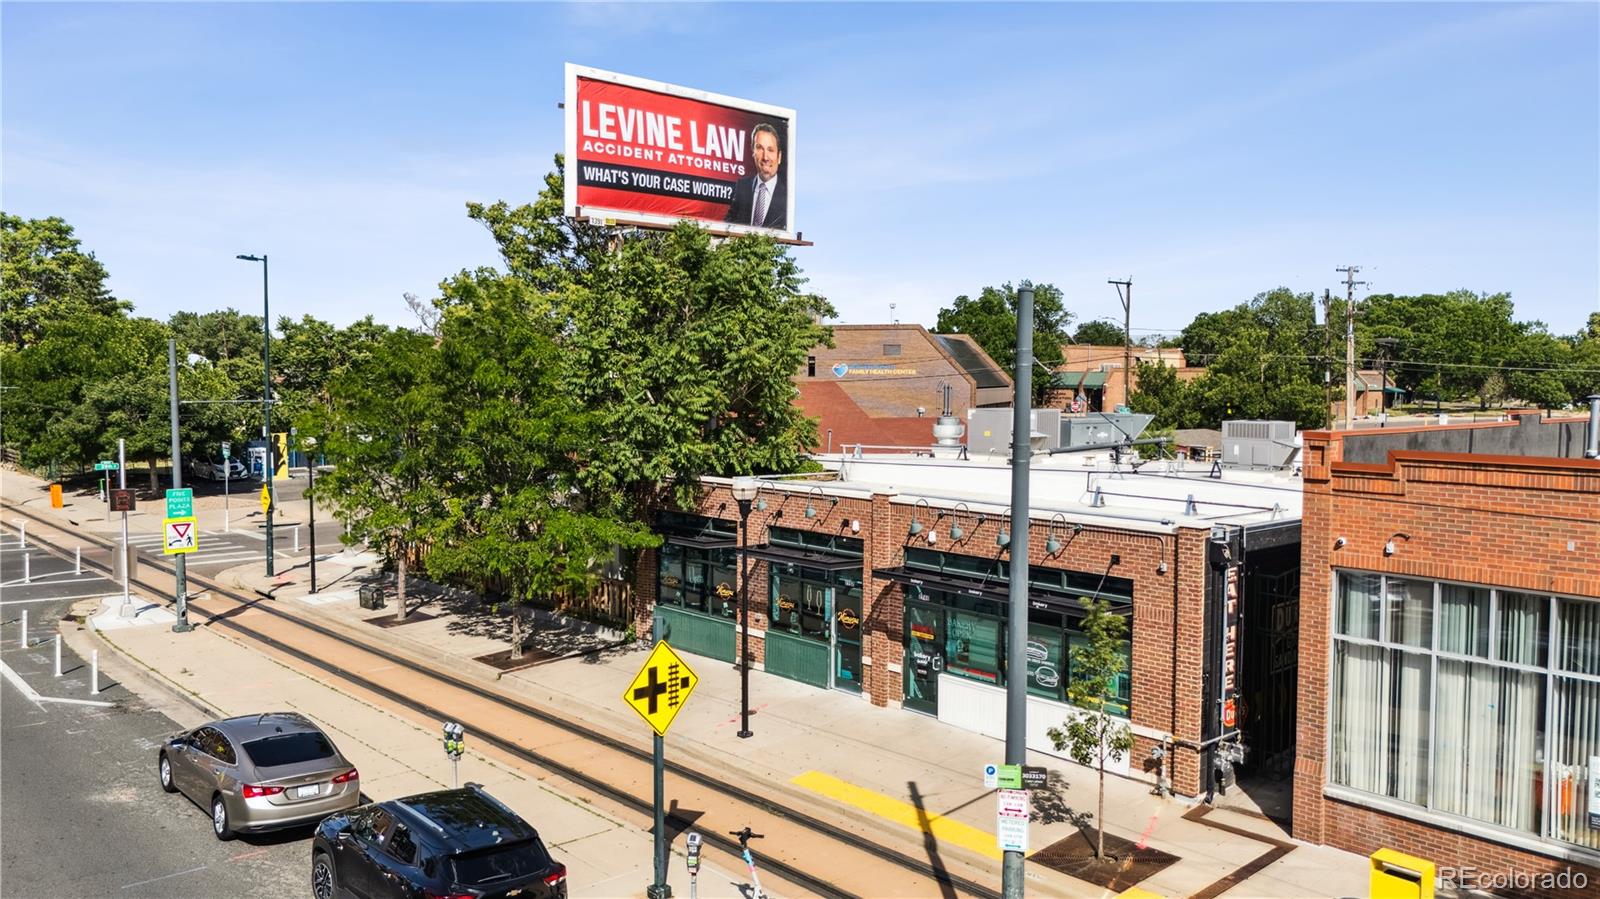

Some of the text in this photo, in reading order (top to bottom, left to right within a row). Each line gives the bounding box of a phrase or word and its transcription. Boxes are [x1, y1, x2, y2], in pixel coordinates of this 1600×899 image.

[582, 100, 746, 162] LEVINE LAW
[583, 140, 746, 176] ACCIDENT ATTORNEYS
[583, 166, 733, 200] WHAT'S YOUR CASE WORTH?
[1226, 566, 1238, 615] EAT
[1225, 624, 1237, 691] HERE
